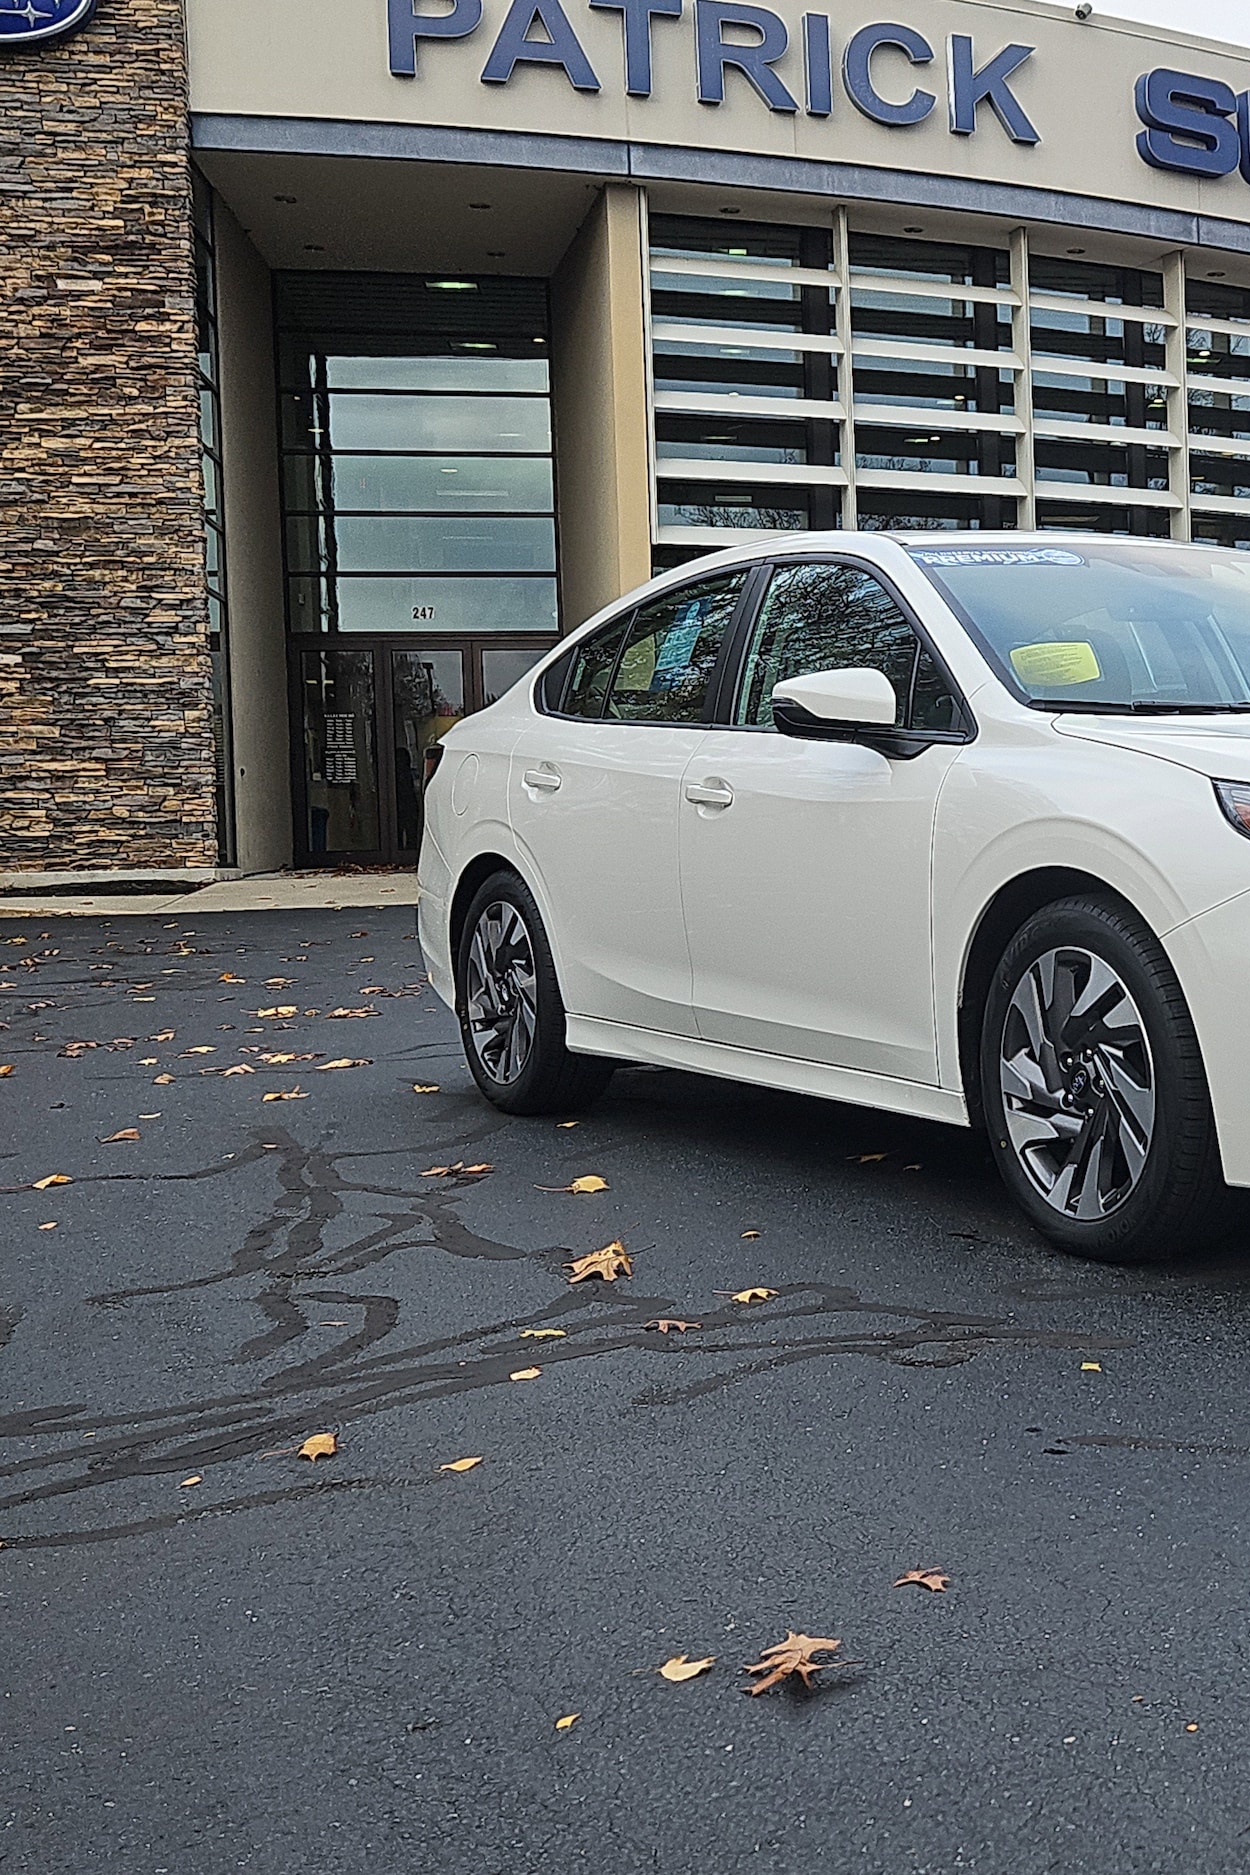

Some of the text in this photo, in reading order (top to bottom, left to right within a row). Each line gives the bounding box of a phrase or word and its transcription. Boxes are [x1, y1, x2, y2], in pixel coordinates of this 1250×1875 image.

[385, 0, 1043, 147] PATRICK
[921, 551, 1041, 565] PREMIUM
[412, 606, 434, 620] 247
